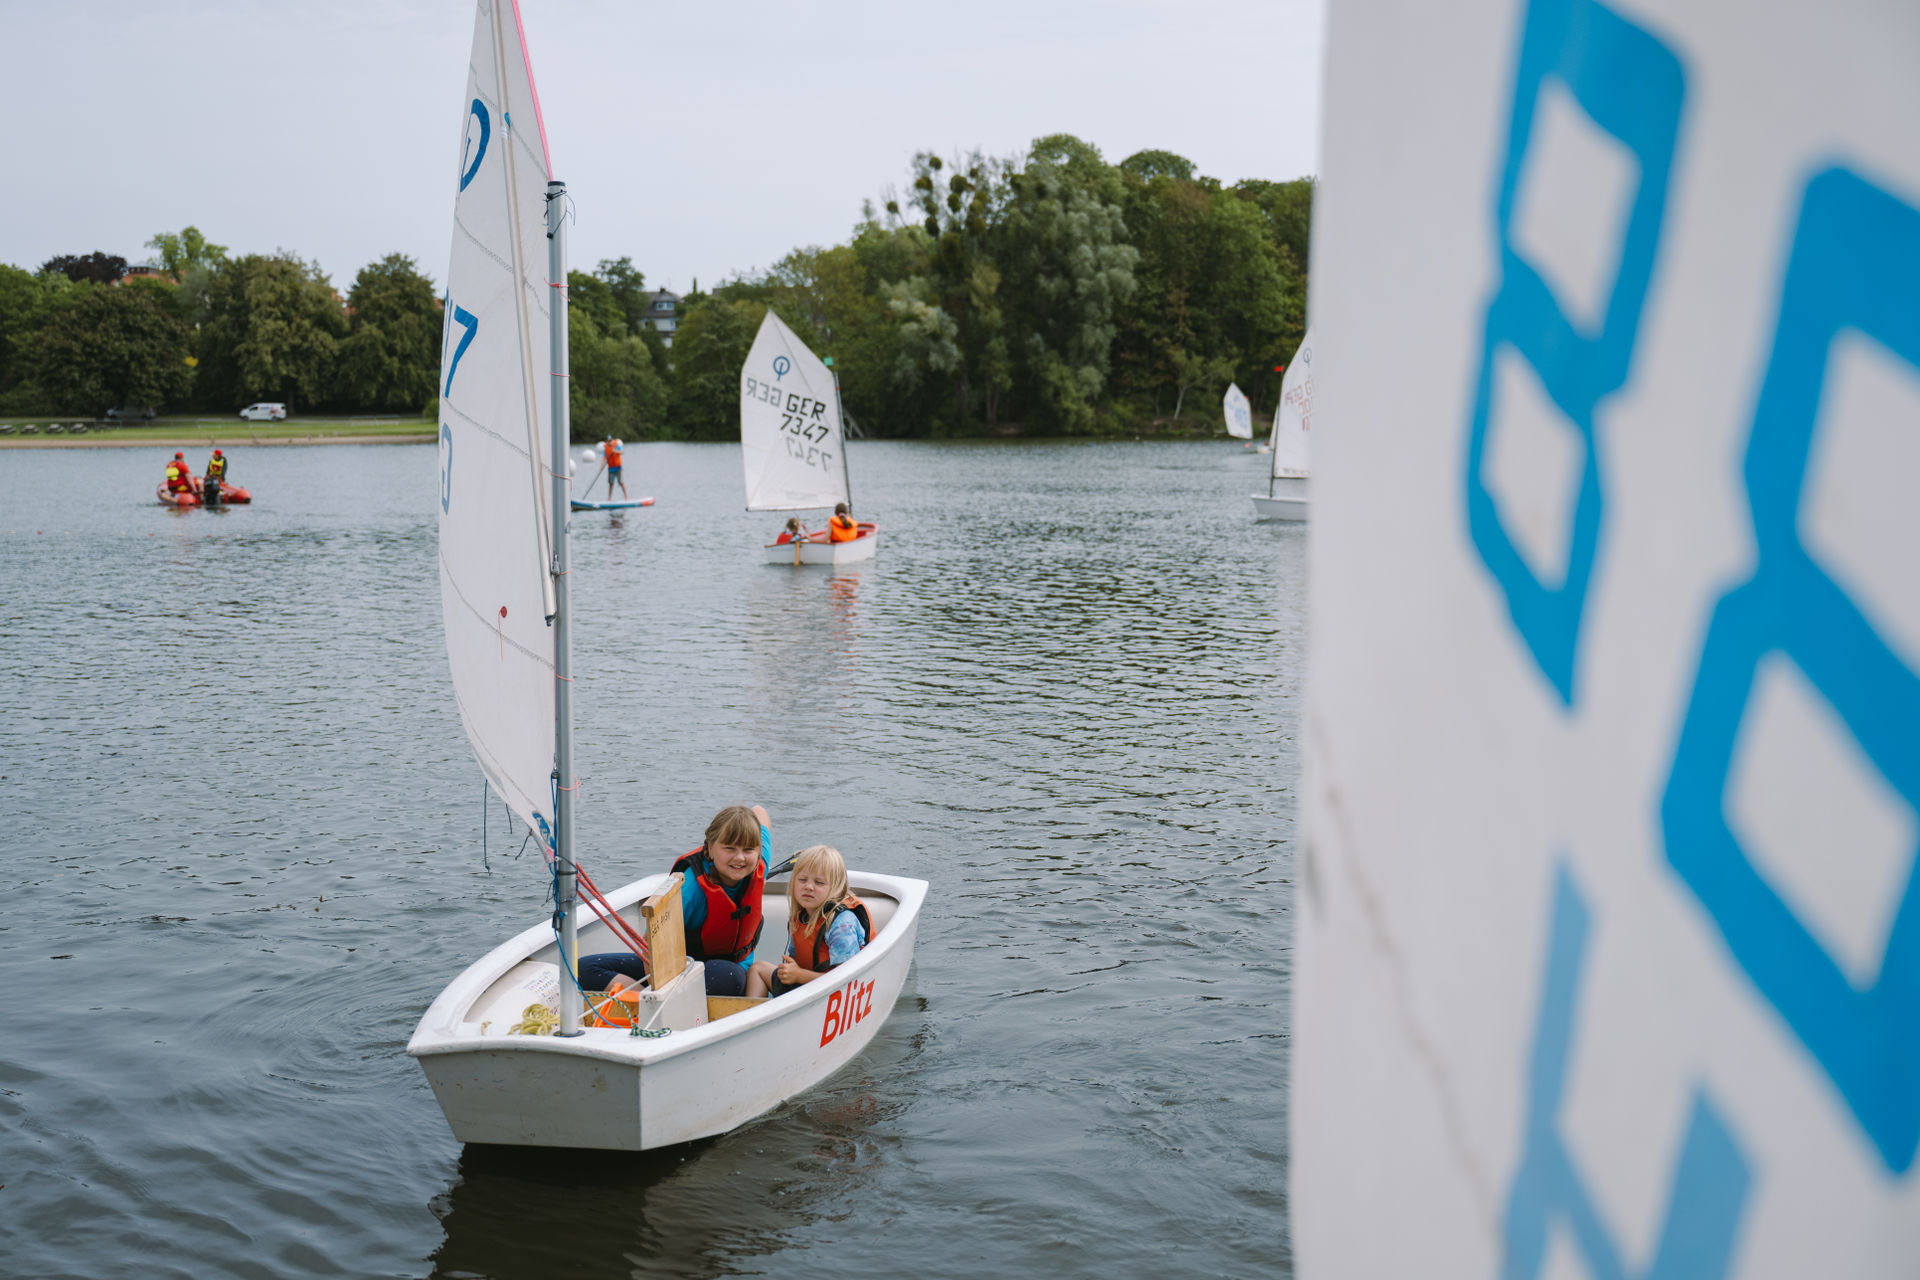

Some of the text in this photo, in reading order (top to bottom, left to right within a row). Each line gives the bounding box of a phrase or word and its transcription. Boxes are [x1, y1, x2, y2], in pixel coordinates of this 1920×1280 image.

[786, 393, 826, 421] GER
[780, 413, 829, 443] 7347
[820, 978, 875, 1048] Blitz
